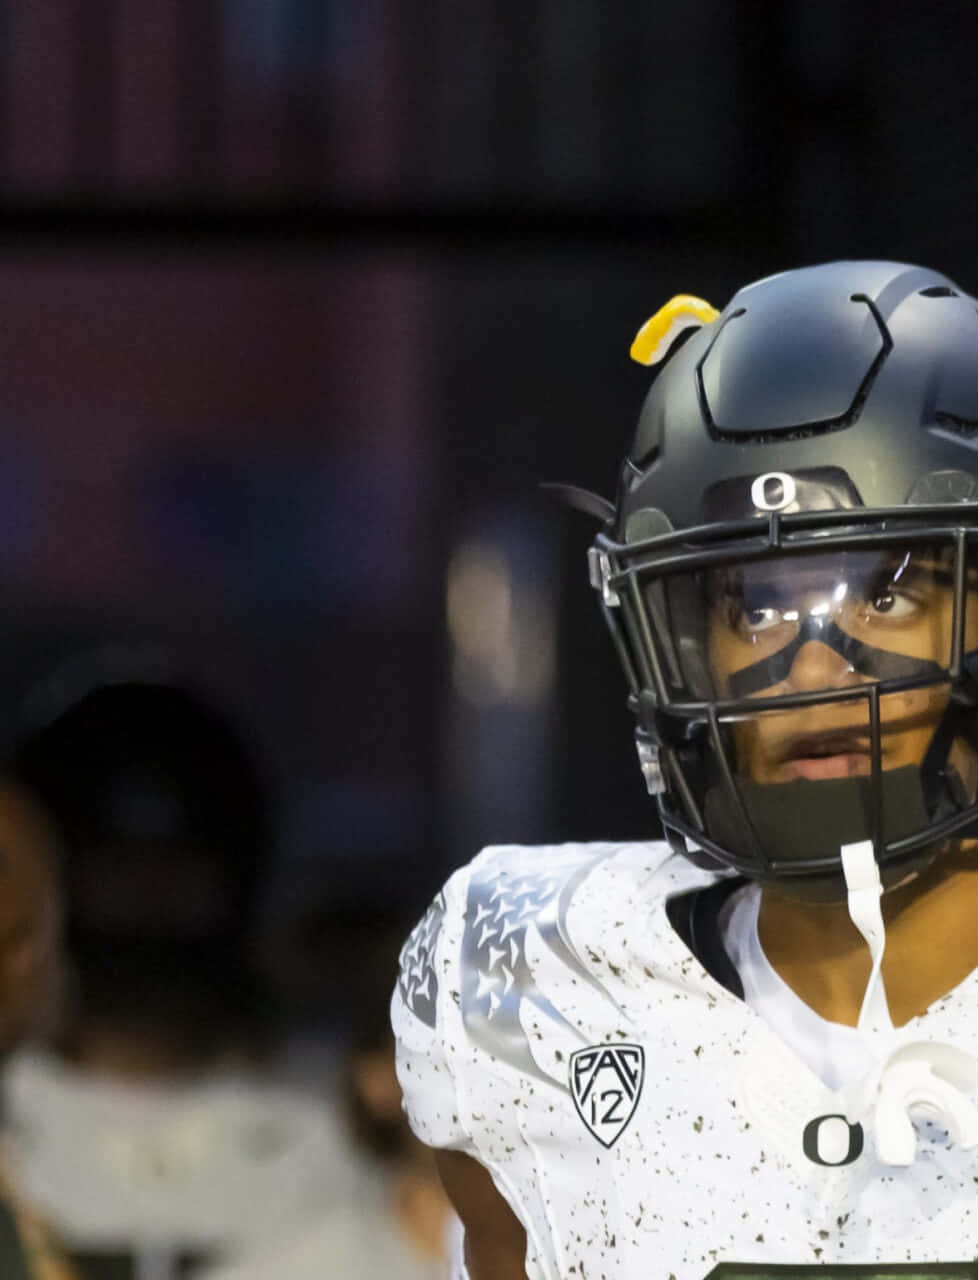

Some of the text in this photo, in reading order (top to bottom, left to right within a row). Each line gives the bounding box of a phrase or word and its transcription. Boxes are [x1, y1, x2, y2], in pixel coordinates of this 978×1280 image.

[751, 471, 796, 511] O
[574, 1049, 639, 1107] PAC
[591, 1090, 625, 1126] 12
[802, 1114, 864, 1168] O
